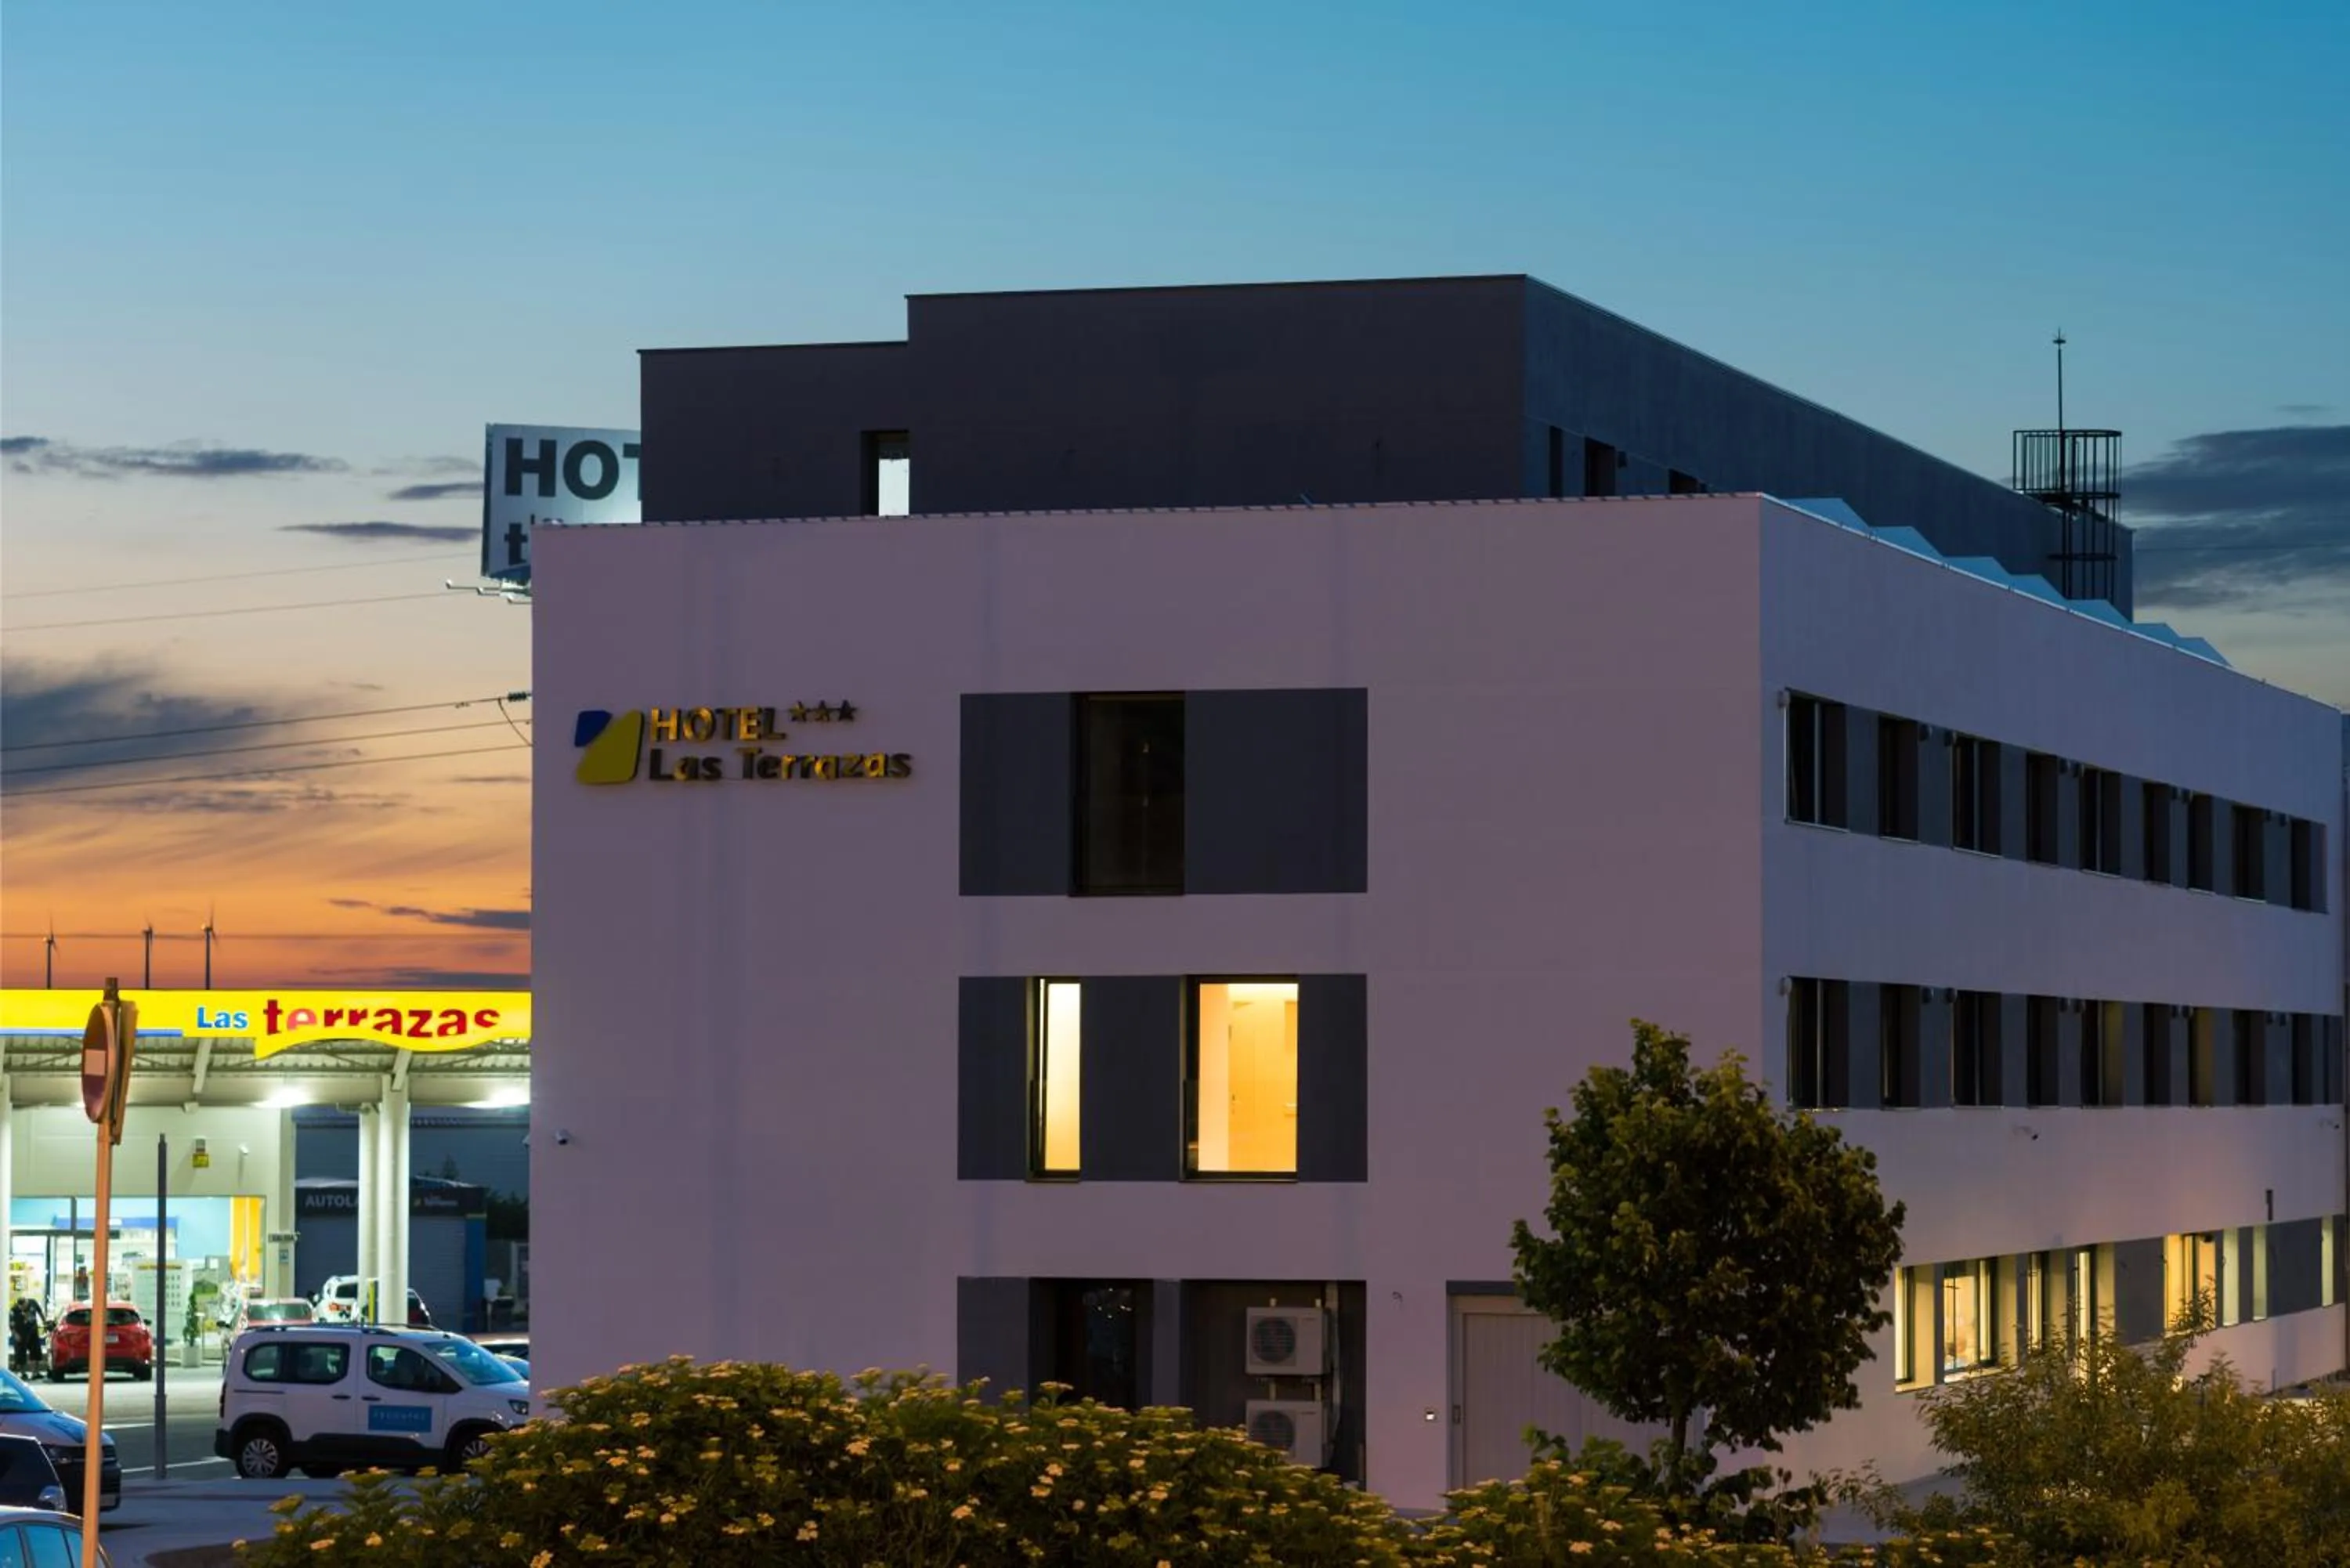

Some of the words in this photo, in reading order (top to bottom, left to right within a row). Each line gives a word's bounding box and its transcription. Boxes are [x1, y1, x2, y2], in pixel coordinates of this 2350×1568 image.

[649, 706, 786, 742] HOTEL
[649, 748, 724, 782] Las
[734, 746, 913, 780] Terrazas
[197, 1006, 248, 1029] Las
[263, 999, 501, 1038] terrazas
